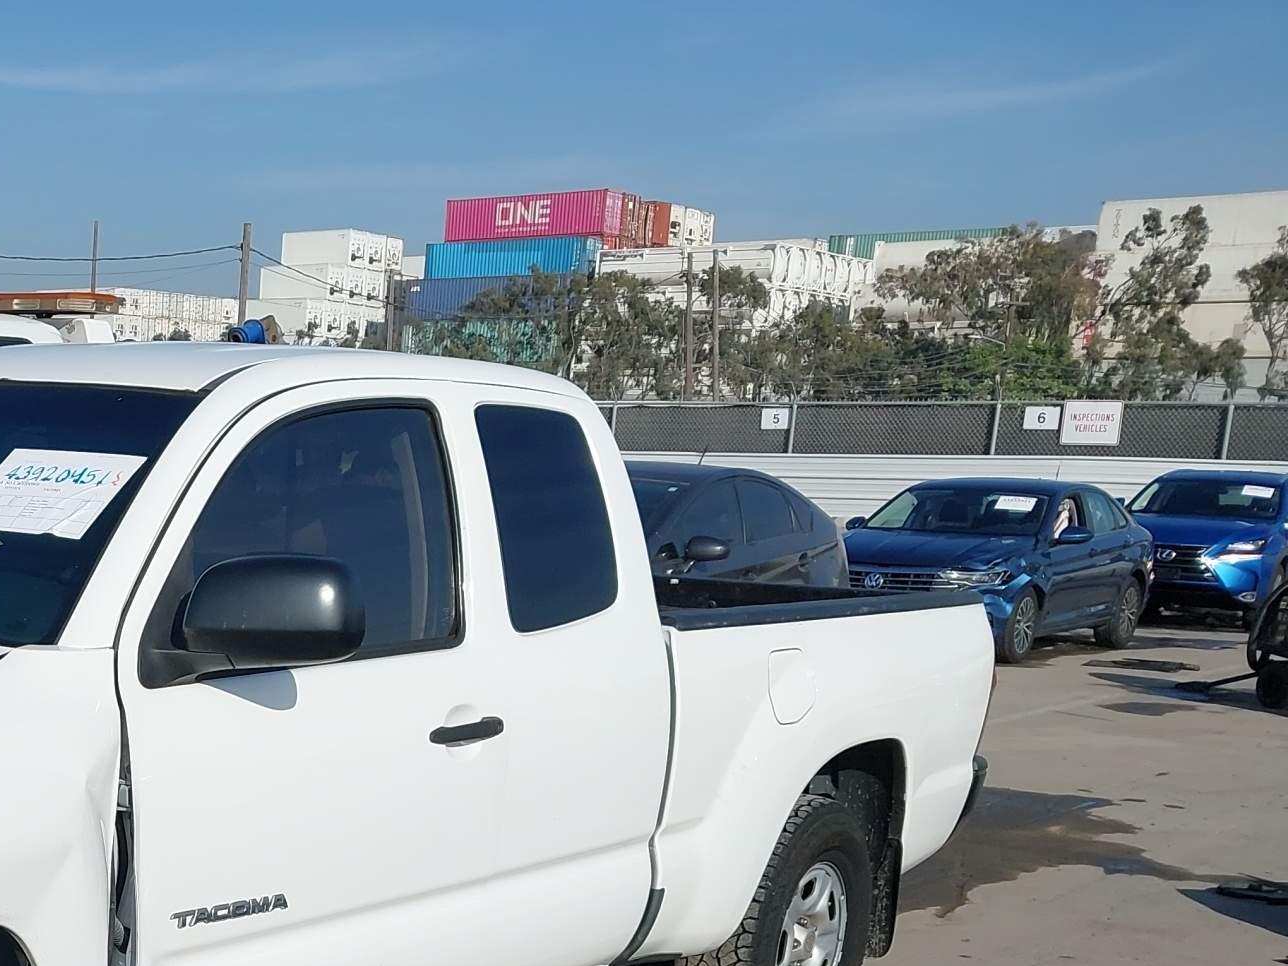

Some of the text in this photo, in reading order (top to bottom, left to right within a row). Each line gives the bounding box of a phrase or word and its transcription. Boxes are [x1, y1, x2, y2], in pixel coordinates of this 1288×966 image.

[496, 199, 551, 224] ONE
[772, 413, 780, 424] 5
[1037, 412, 1047, 424] 6
[1070, 413, 1115, 423] INSPECTIONS
[1074, 424, 1108, 433] VEHICLES
[5, 464, 112, 487] 43920451
[170, 893, 289, 929] TACOMA
